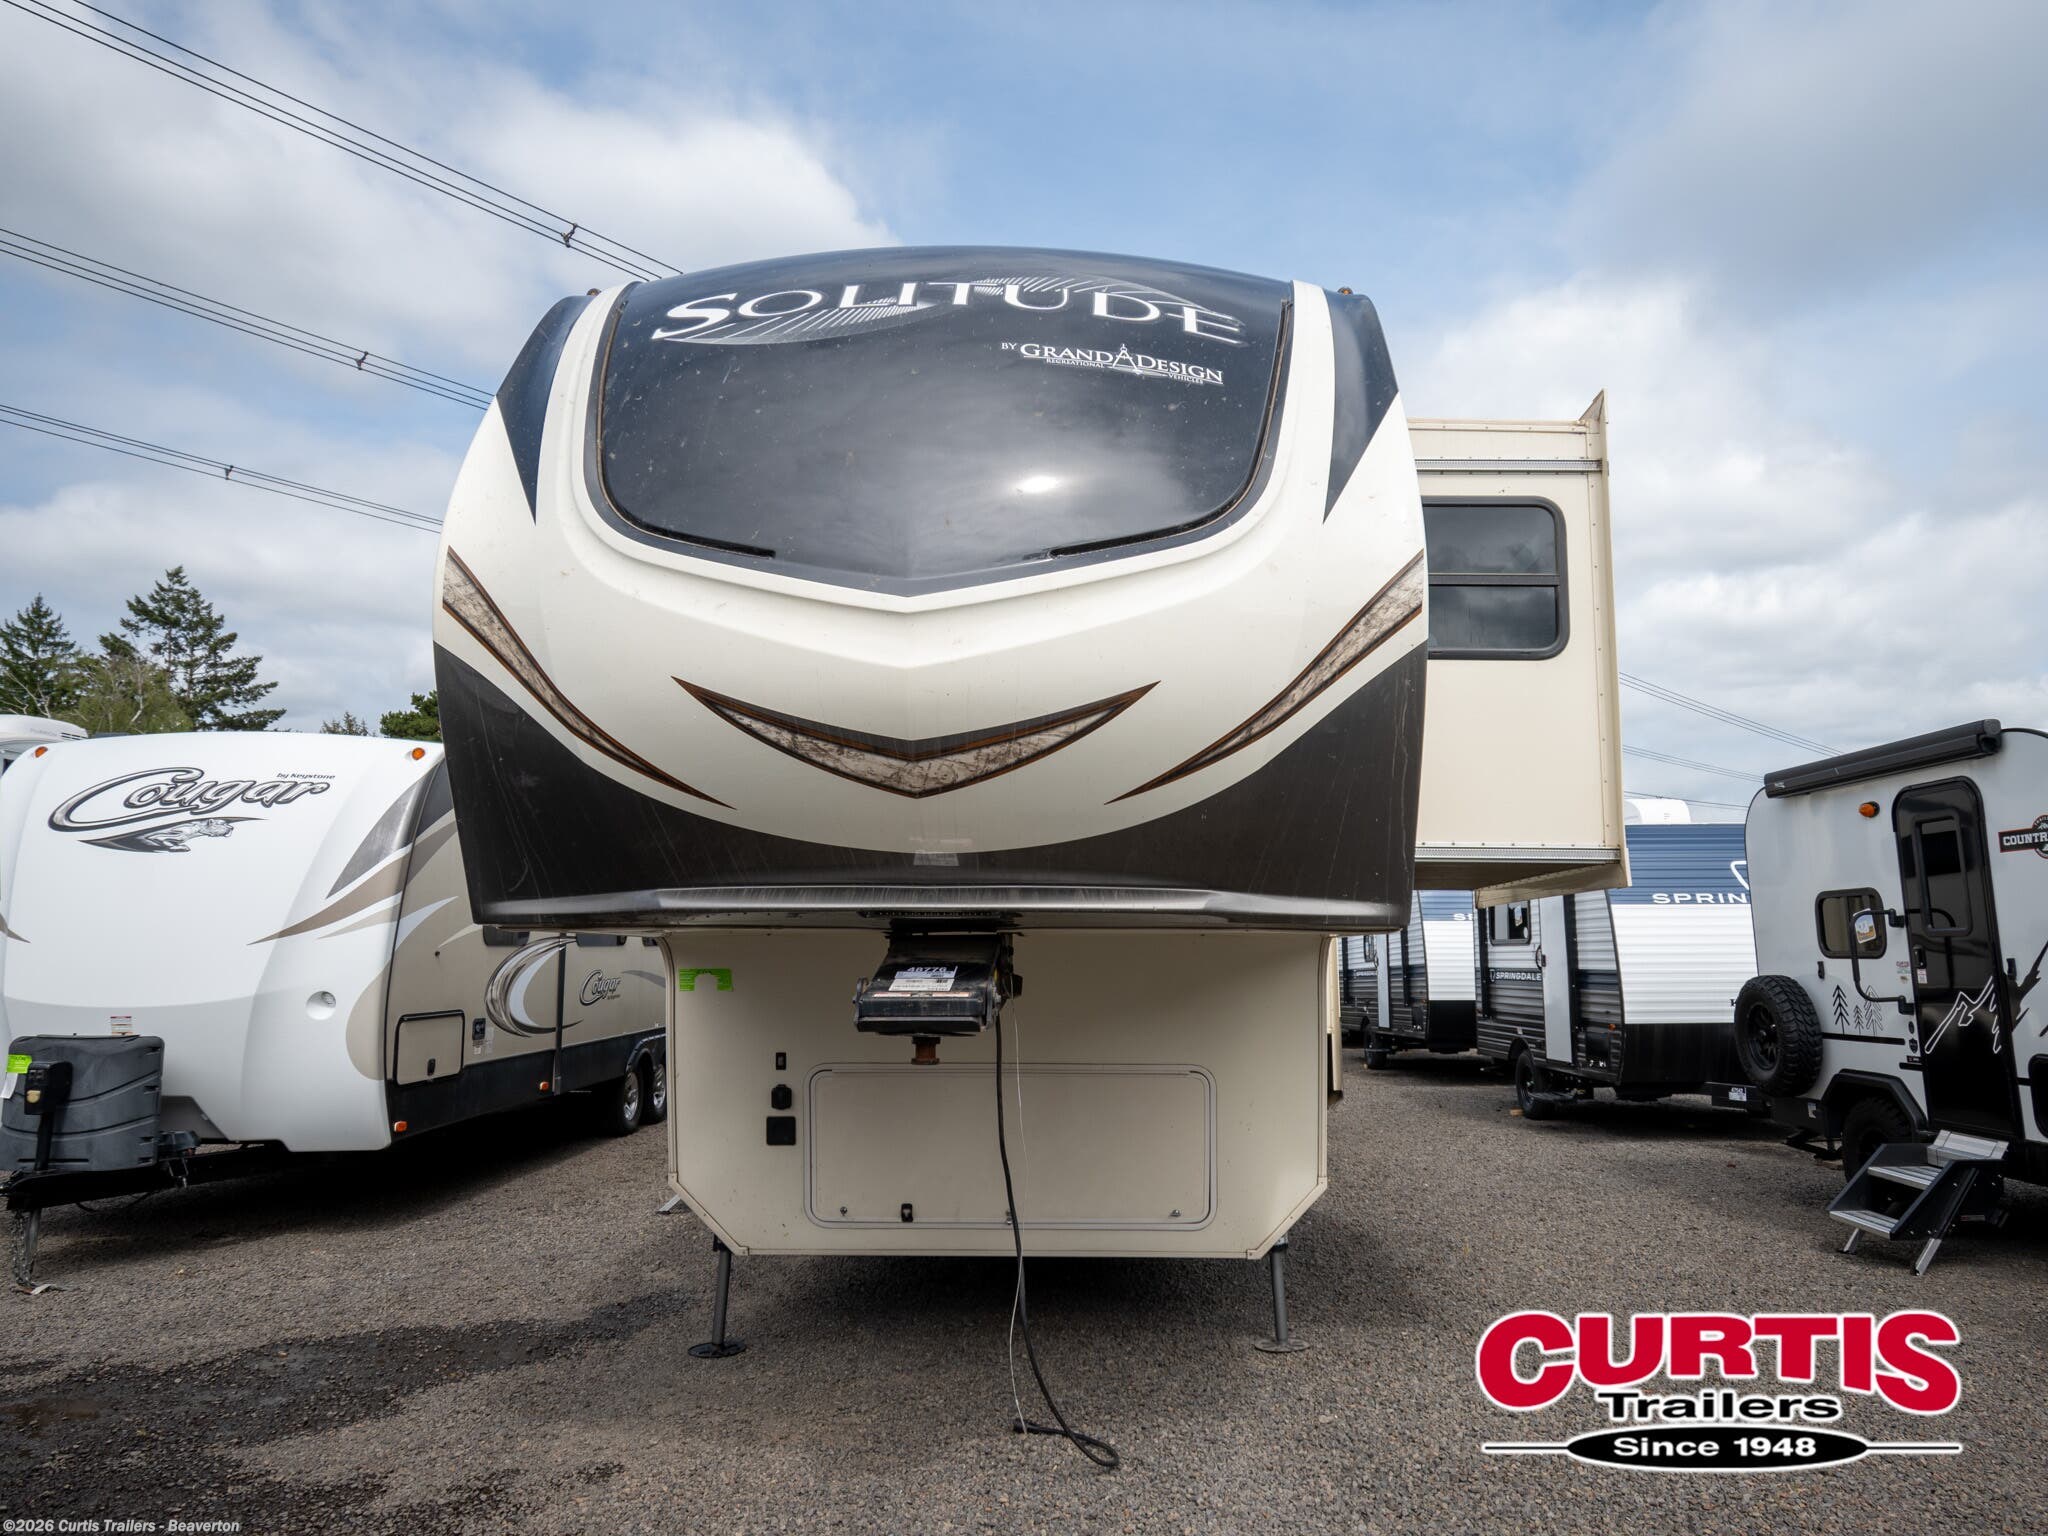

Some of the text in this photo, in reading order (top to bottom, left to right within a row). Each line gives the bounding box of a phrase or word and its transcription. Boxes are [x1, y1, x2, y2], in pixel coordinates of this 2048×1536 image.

[652, 282, 1241, 343] SOLITUDE
[1001, 342, 1223, 382] BY GRAND DESIGN
[47, 766, 330, 832] Cougar
[1495, 971, 1542, 981] SPRINGDALE
